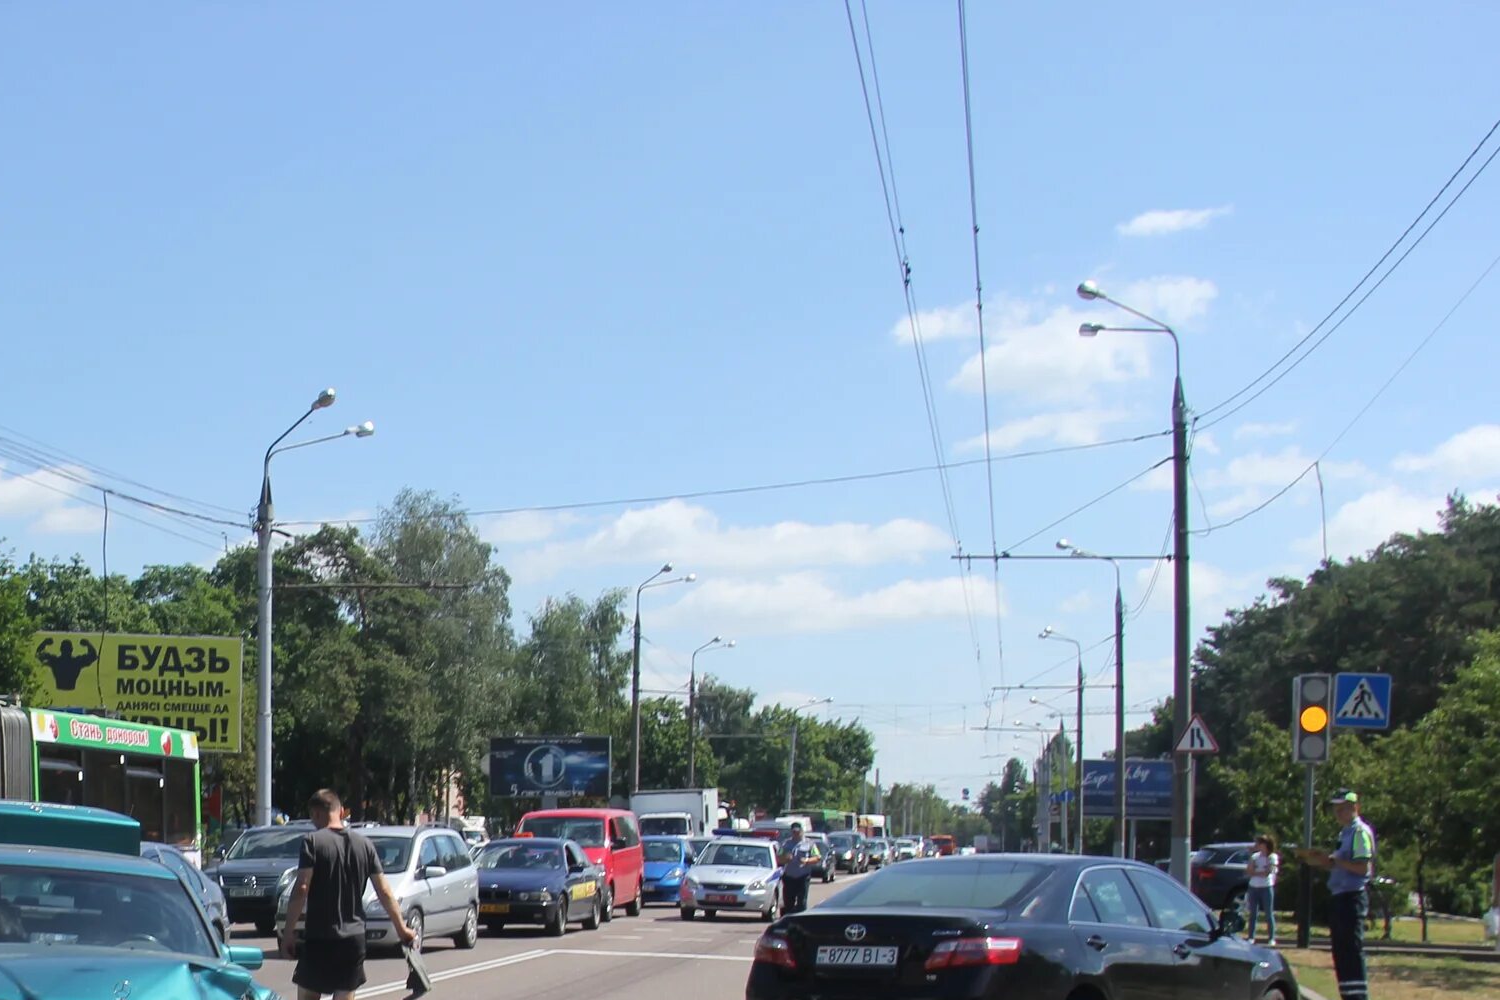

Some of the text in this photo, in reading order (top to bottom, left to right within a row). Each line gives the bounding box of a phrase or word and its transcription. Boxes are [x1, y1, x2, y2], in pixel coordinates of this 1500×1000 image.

[117, 644, 230, 677] БУДЗЬ
[116, 678, 231, 699] МОЦНЫМ-
[214, 703, 229, 714] ДА
[71, 719, 102, 741] Стань
[107, 727, 150, 745] донором!
[828, 949, 858, 963] 8777
[863, 949, 895, 963] BI-3
